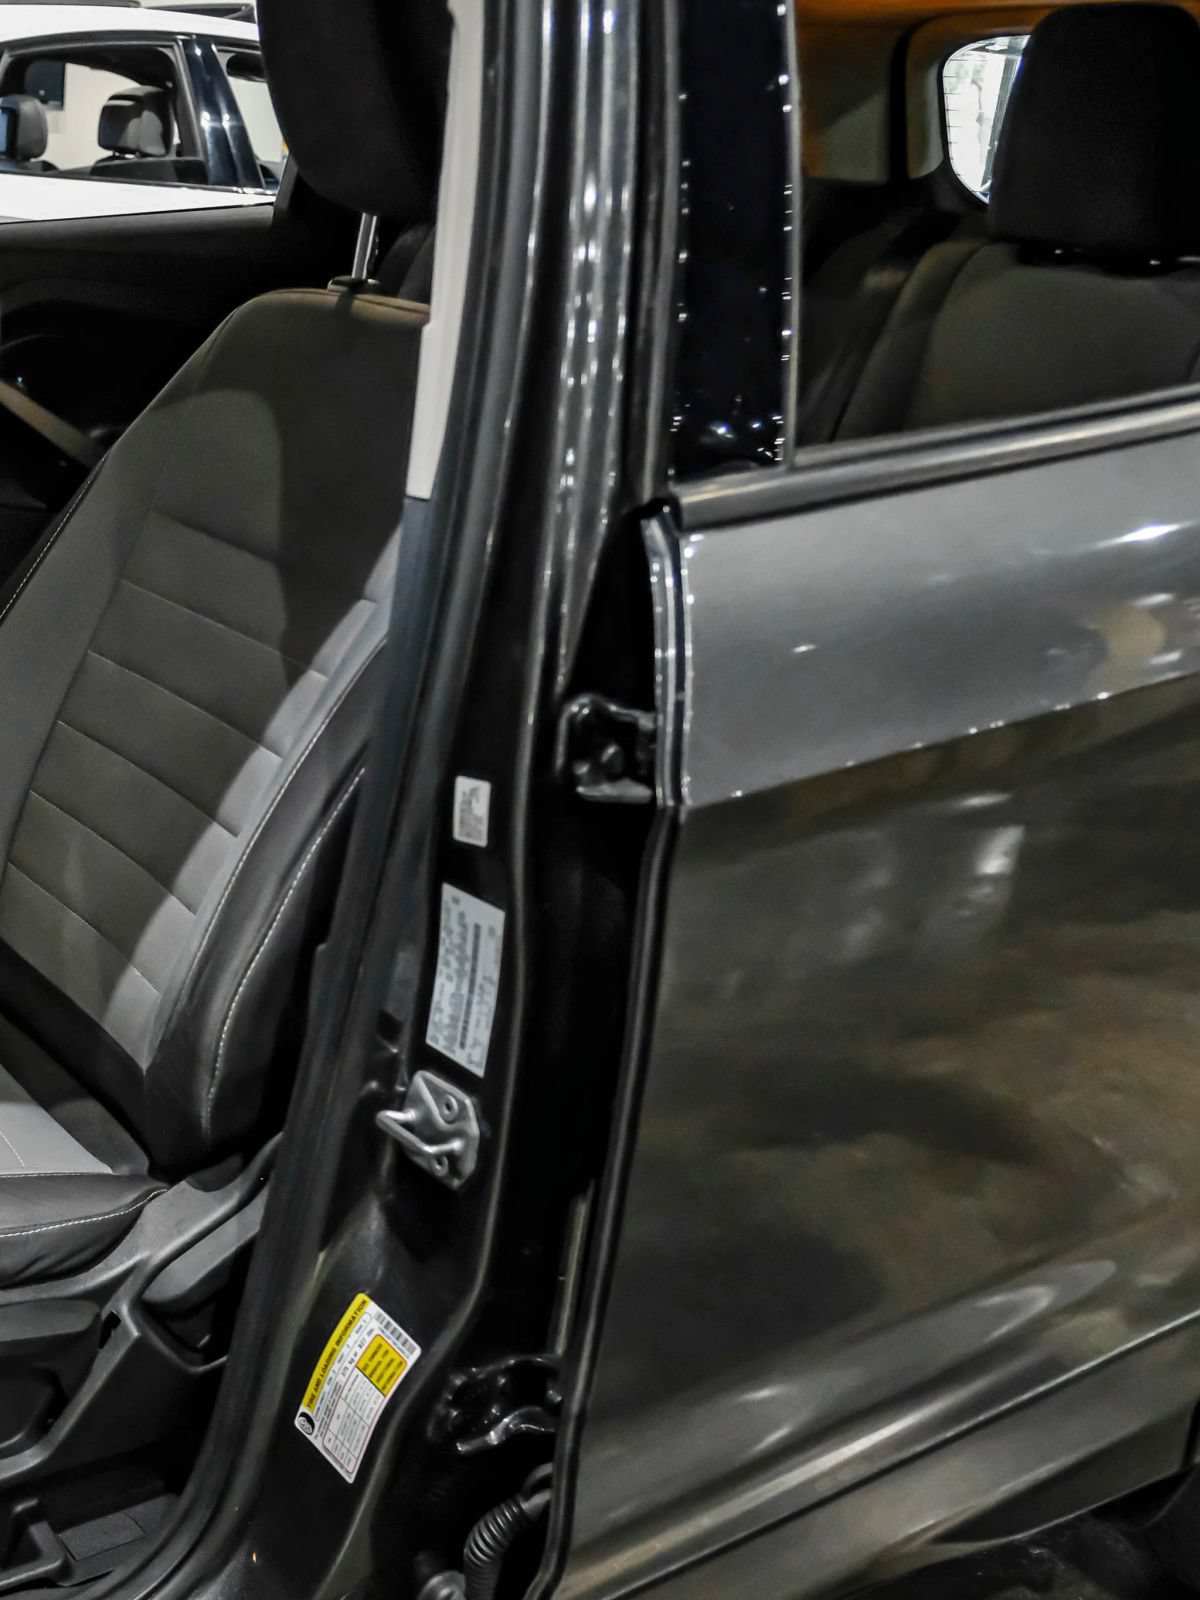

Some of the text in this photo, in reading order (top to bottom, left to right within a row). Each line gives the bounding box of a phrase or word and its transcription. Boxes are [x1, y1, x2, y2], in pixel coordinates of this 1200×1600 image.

[307, 1393, 317, 1409] TIRE
[313, 1378, 322, 1392] AND
[319, 1347, 337, 1377] LOADING
[335, 1299, 367, 1346] INFORMATION
